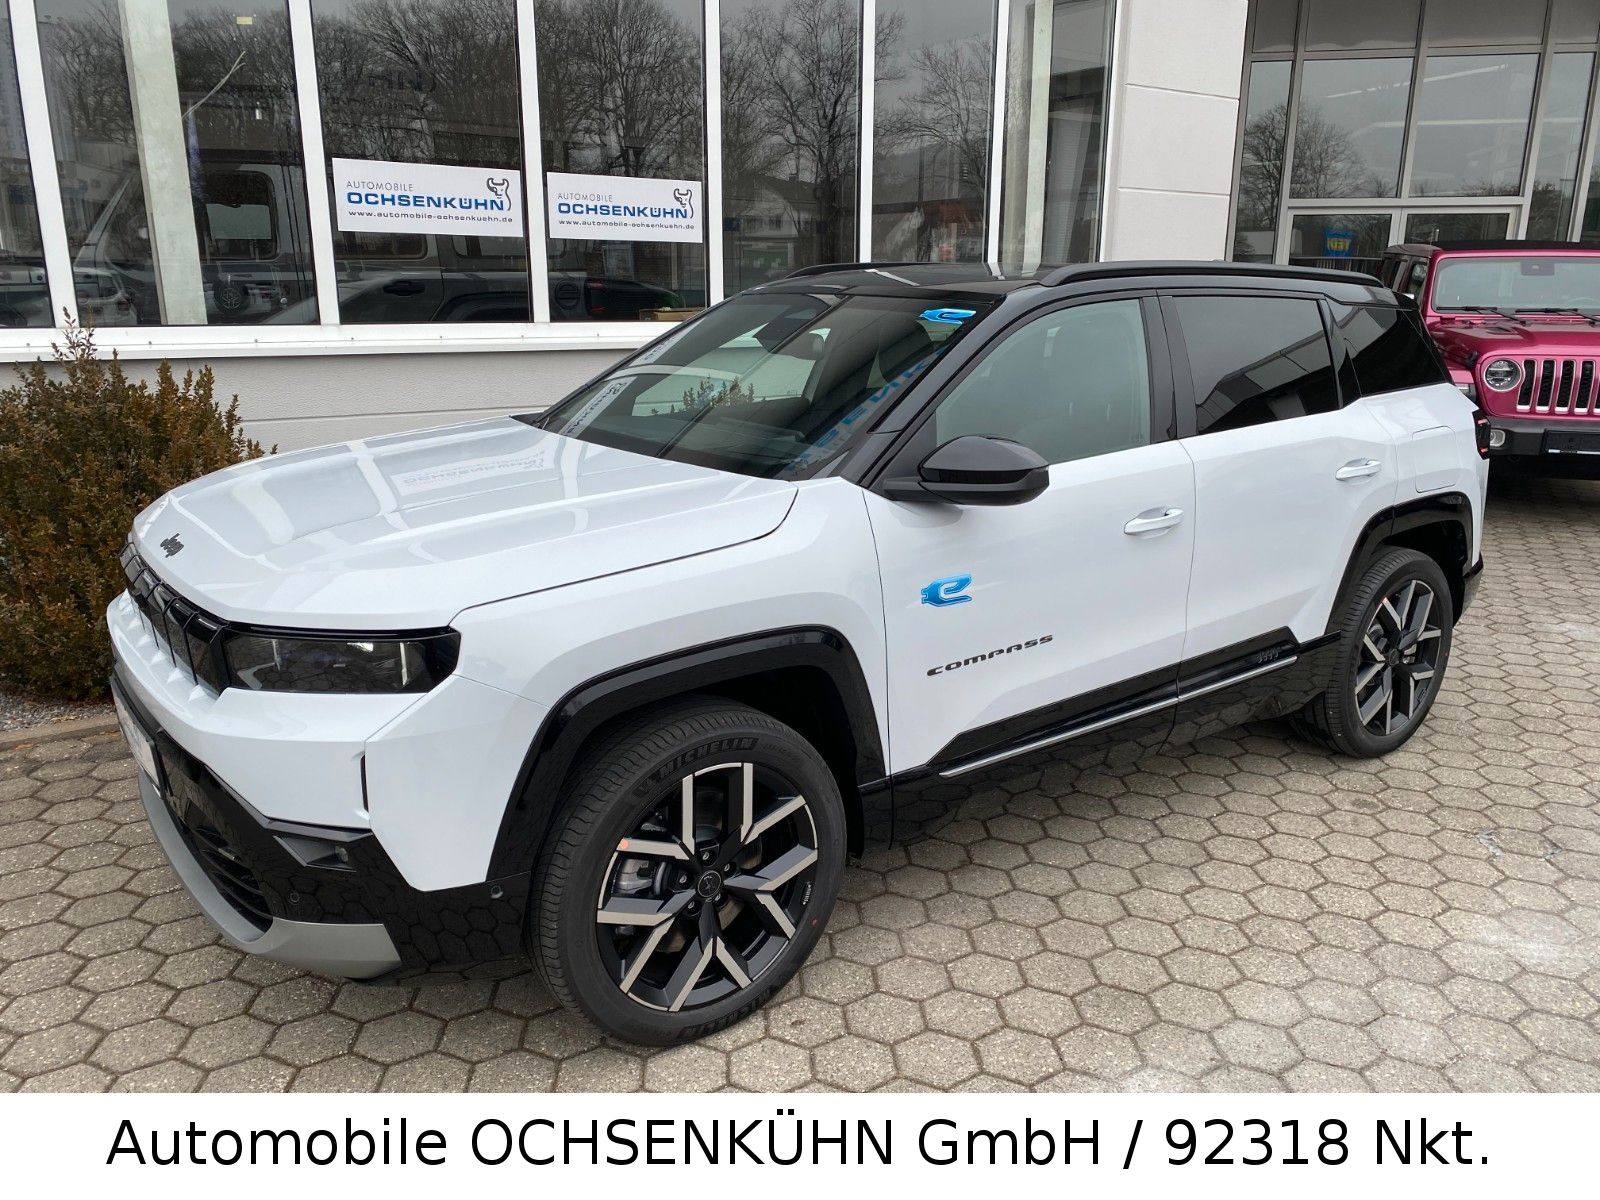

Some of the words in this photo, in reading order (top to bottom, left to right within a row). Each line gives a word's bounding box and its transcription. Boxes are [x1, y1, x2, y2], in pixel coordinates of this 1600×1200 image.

[346, 181, 414, 192] AUTOMOBILE
[346, 192, 504, 211] OCHSENKÜHN
[558, 193, 613, 203] AUTOMOBILE
[557, 203, 688, 219] OCHSENKÜHN
[348, 211, 513, 223] www.automobile-ochsenkuehn.de
[558, 219, 695, 230] www.automobile-ochsenkuehn.de
